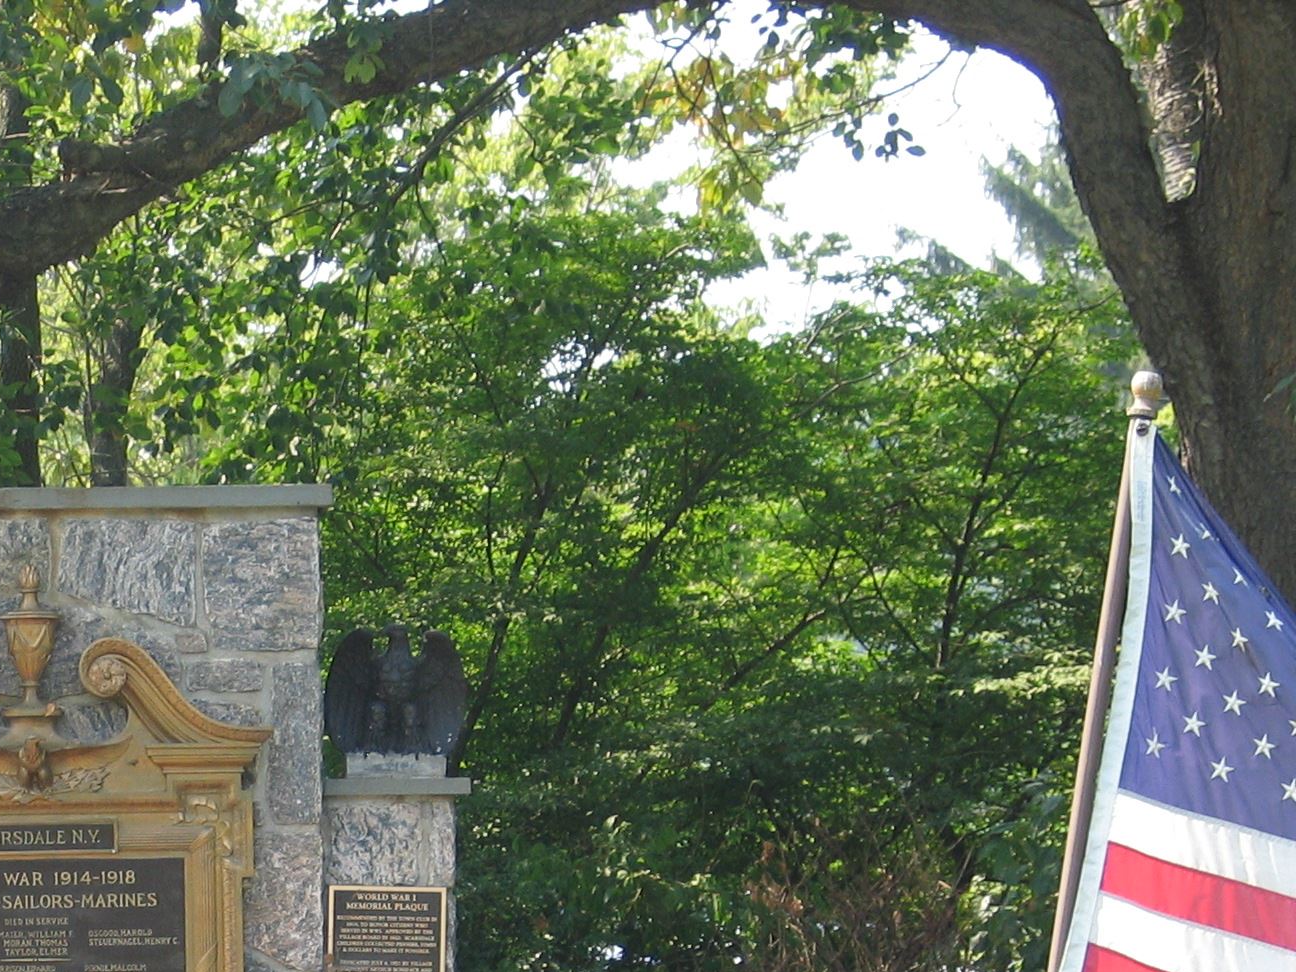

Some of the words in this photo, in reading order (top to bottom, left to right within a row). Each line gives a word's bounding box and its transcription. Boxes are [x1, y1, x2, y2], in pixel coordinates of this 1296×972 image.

[71, 829, 101, 845] N.Y.
[3, 871, 43, 887] WAR
[53, 869, 136, 886] 1914-1918
[357, 893, 389, 901] WORLD
[346, 902, 392, 910] MEMORIAL
[395, 903, 428, 911] PLAQUE
[4, 917, 23, 926] DIED
[25, 917, 35, 926] IN
[36, 917, 69, 926] SERVICE
[28, 930, 67, 938] WILLIAM
[35, 939, 69, 947] THOMAS
